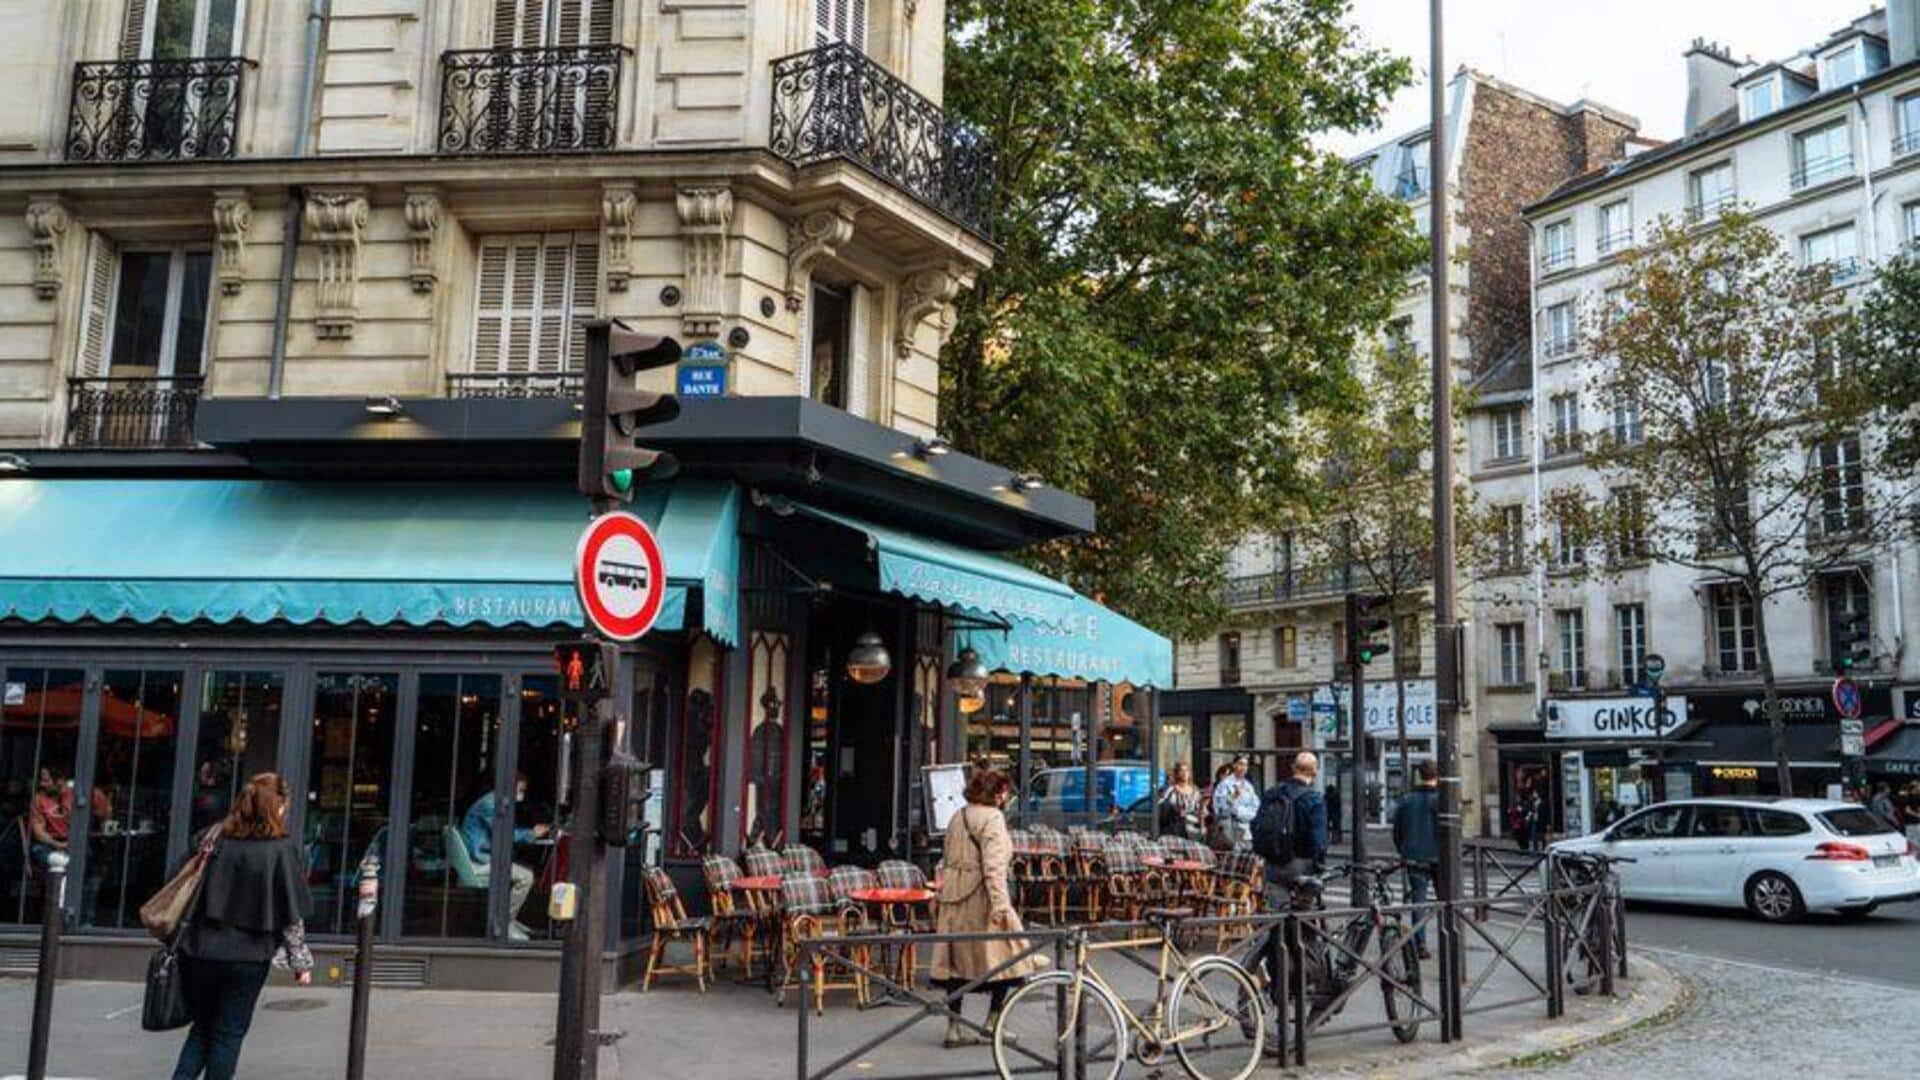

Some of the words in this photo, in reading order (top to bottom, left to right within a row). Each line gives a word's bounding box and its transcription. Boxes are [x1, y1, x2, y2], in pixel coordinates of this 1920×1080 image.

[691, 370, 714, 381] RUE
[683, 383, 720, 395] DANTE
[455, 597, 572, 617] RESTAURAN
[1010, 644, 1120, 672] RESTAURANT
[1387, 703, 1432, 725] EOLE
